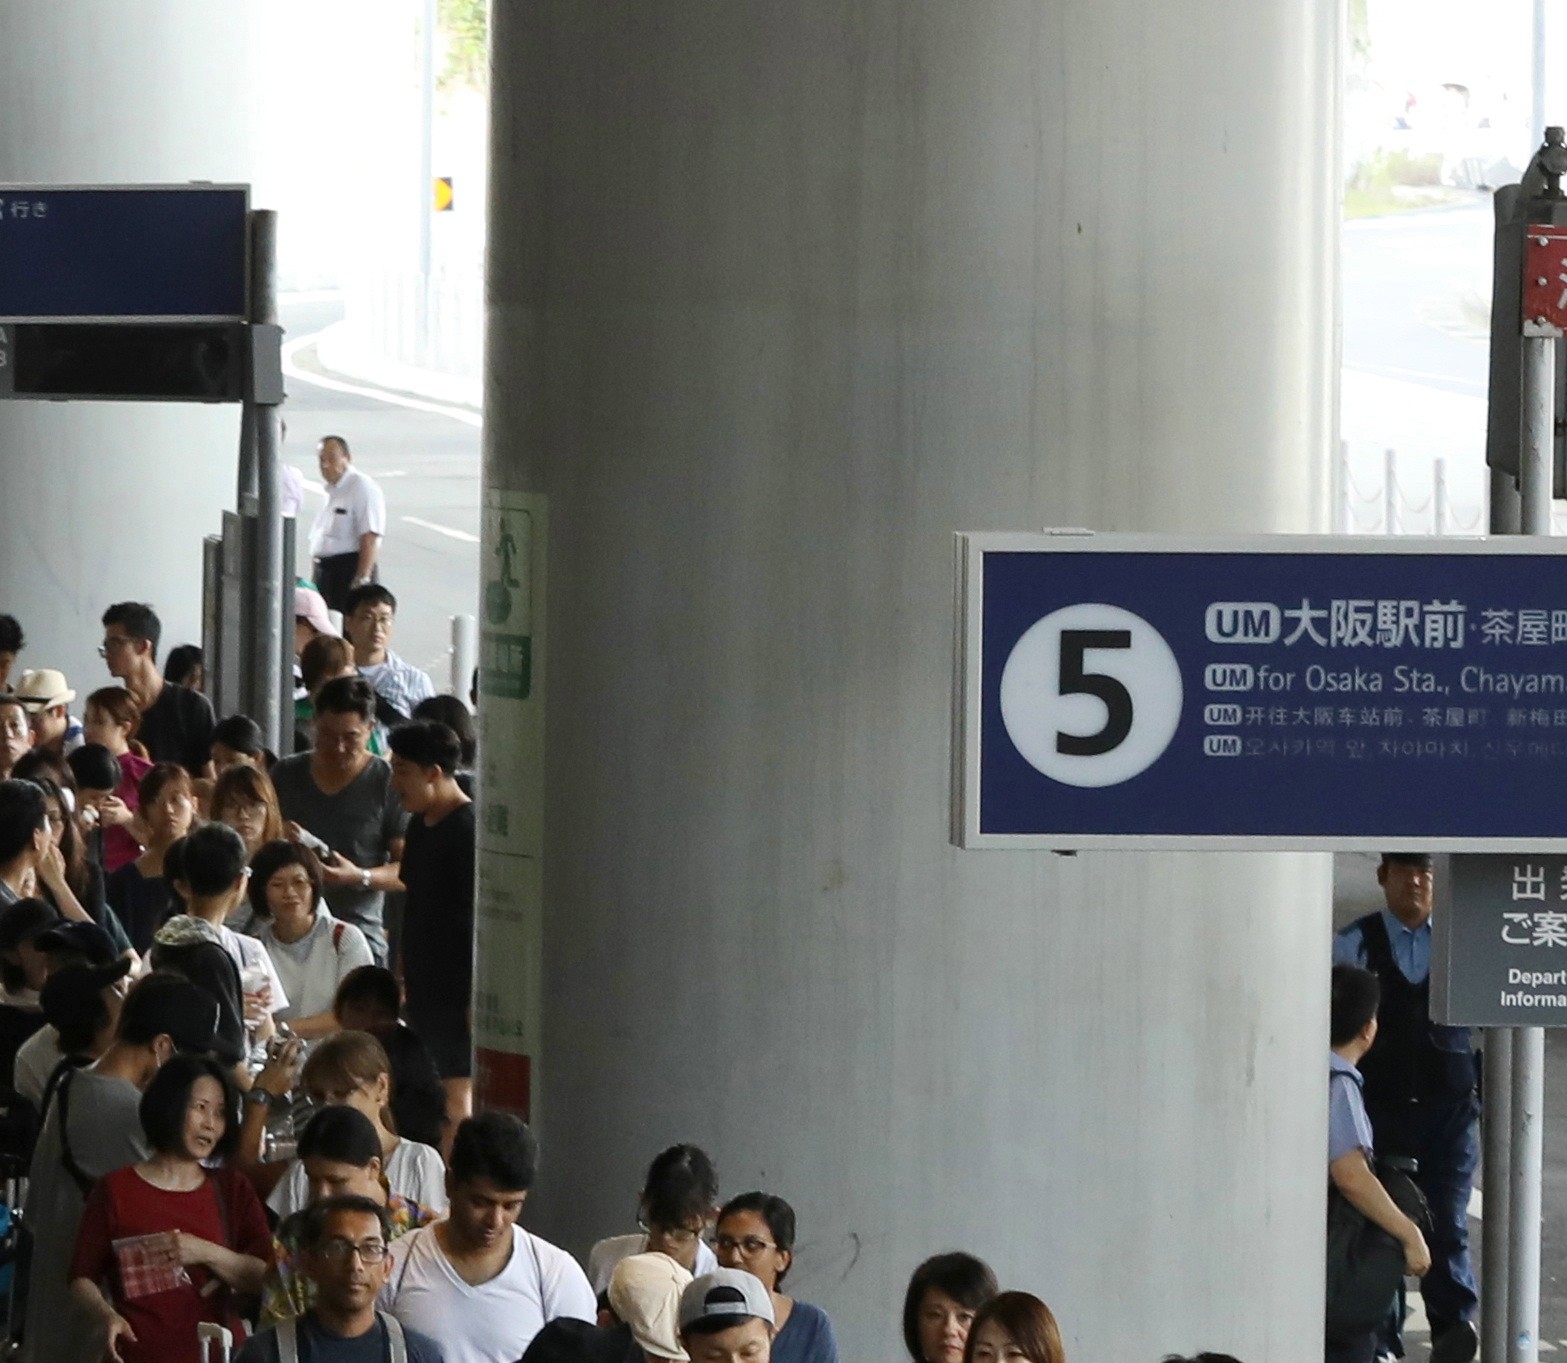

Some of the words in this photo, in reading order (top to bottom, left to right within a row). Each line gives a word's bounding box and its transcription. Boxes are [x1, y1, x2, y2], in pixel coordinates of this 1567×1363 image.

[11, 200, 48, 219] 行き
[1213, 607, 1272, 639] UM
[1052, 627, 1136, 758] 5
[1212, 668, 1248, 688] UM
[1257, 666, 1295, 691] for
[1305, 666, 1384, 692] Osaka
[1393, 666, 1451, 695] Sta.,
[1209, 707, 1237, 723] UM
[1209, 738, 1237, 754] UM
